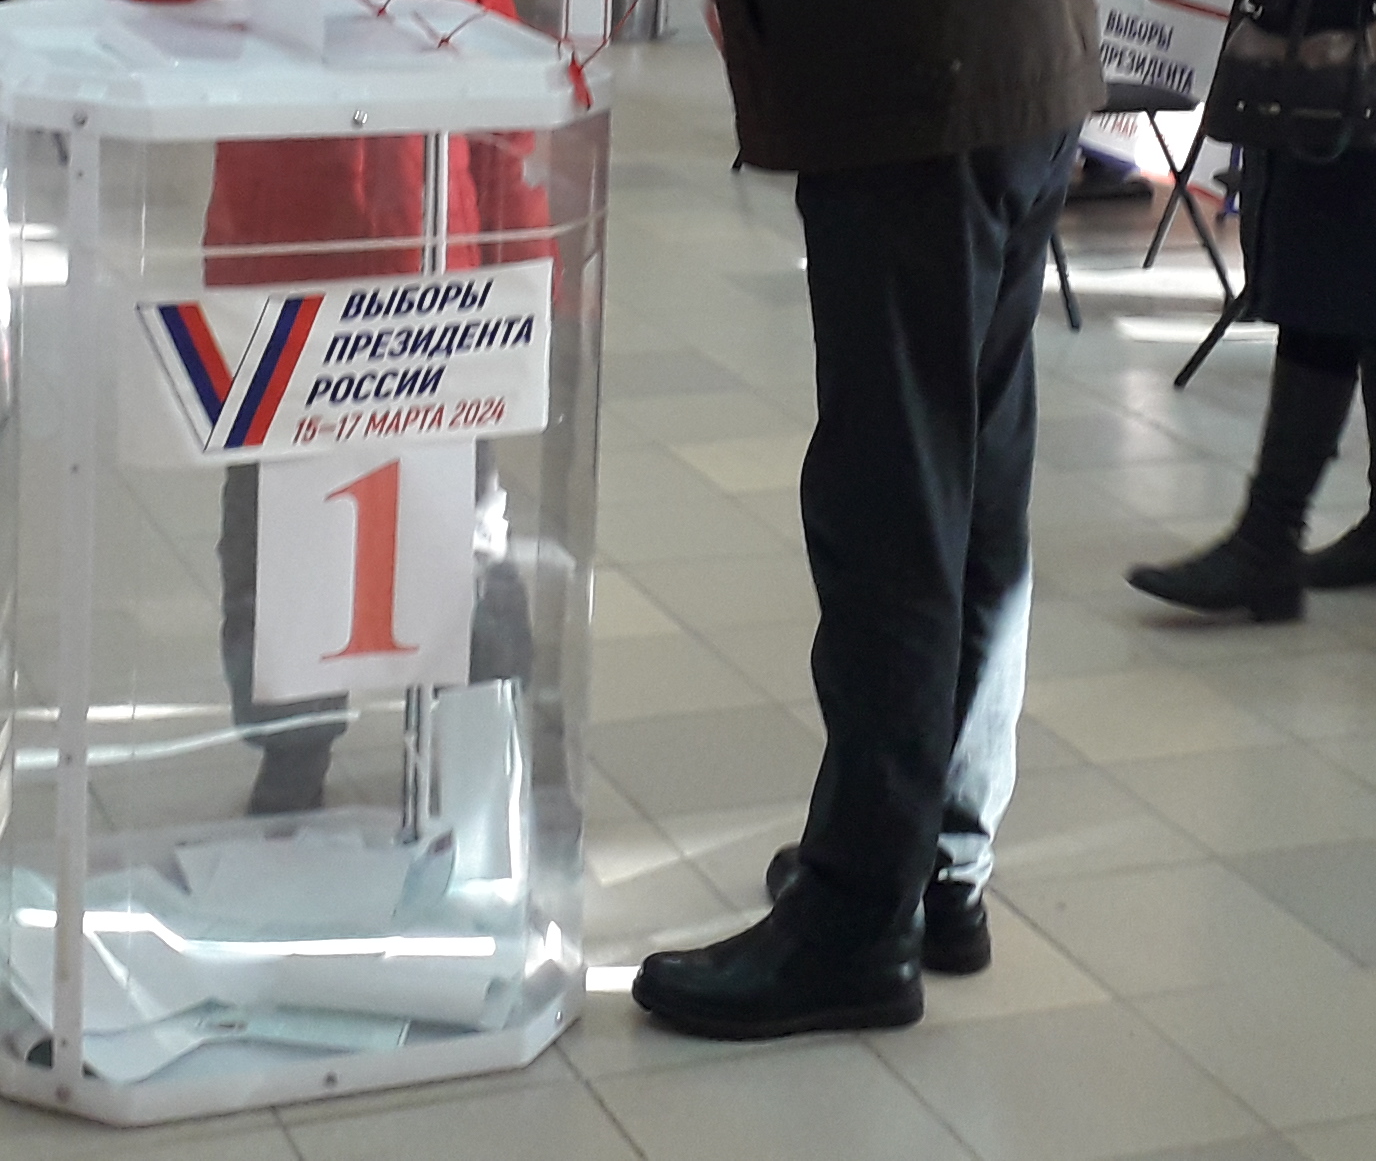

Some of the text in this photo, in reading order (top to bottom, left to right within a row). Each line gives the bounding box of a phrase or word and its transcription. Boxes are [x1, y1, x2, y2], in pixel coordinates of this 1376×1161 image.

[1104, 9, 1174, 53] ВЫБОРЫ
[339, 279, 495, 323] ВЫБОРЫ
[323, 314, 535, 366] ПРЕЗИДЕНТА
[305, 364, 447, 408] РОССИИ
[363, 403, 446, 438] МАРТА
[448, 396, 506, 430] 2024
[319, 457, 420, 663] 1
